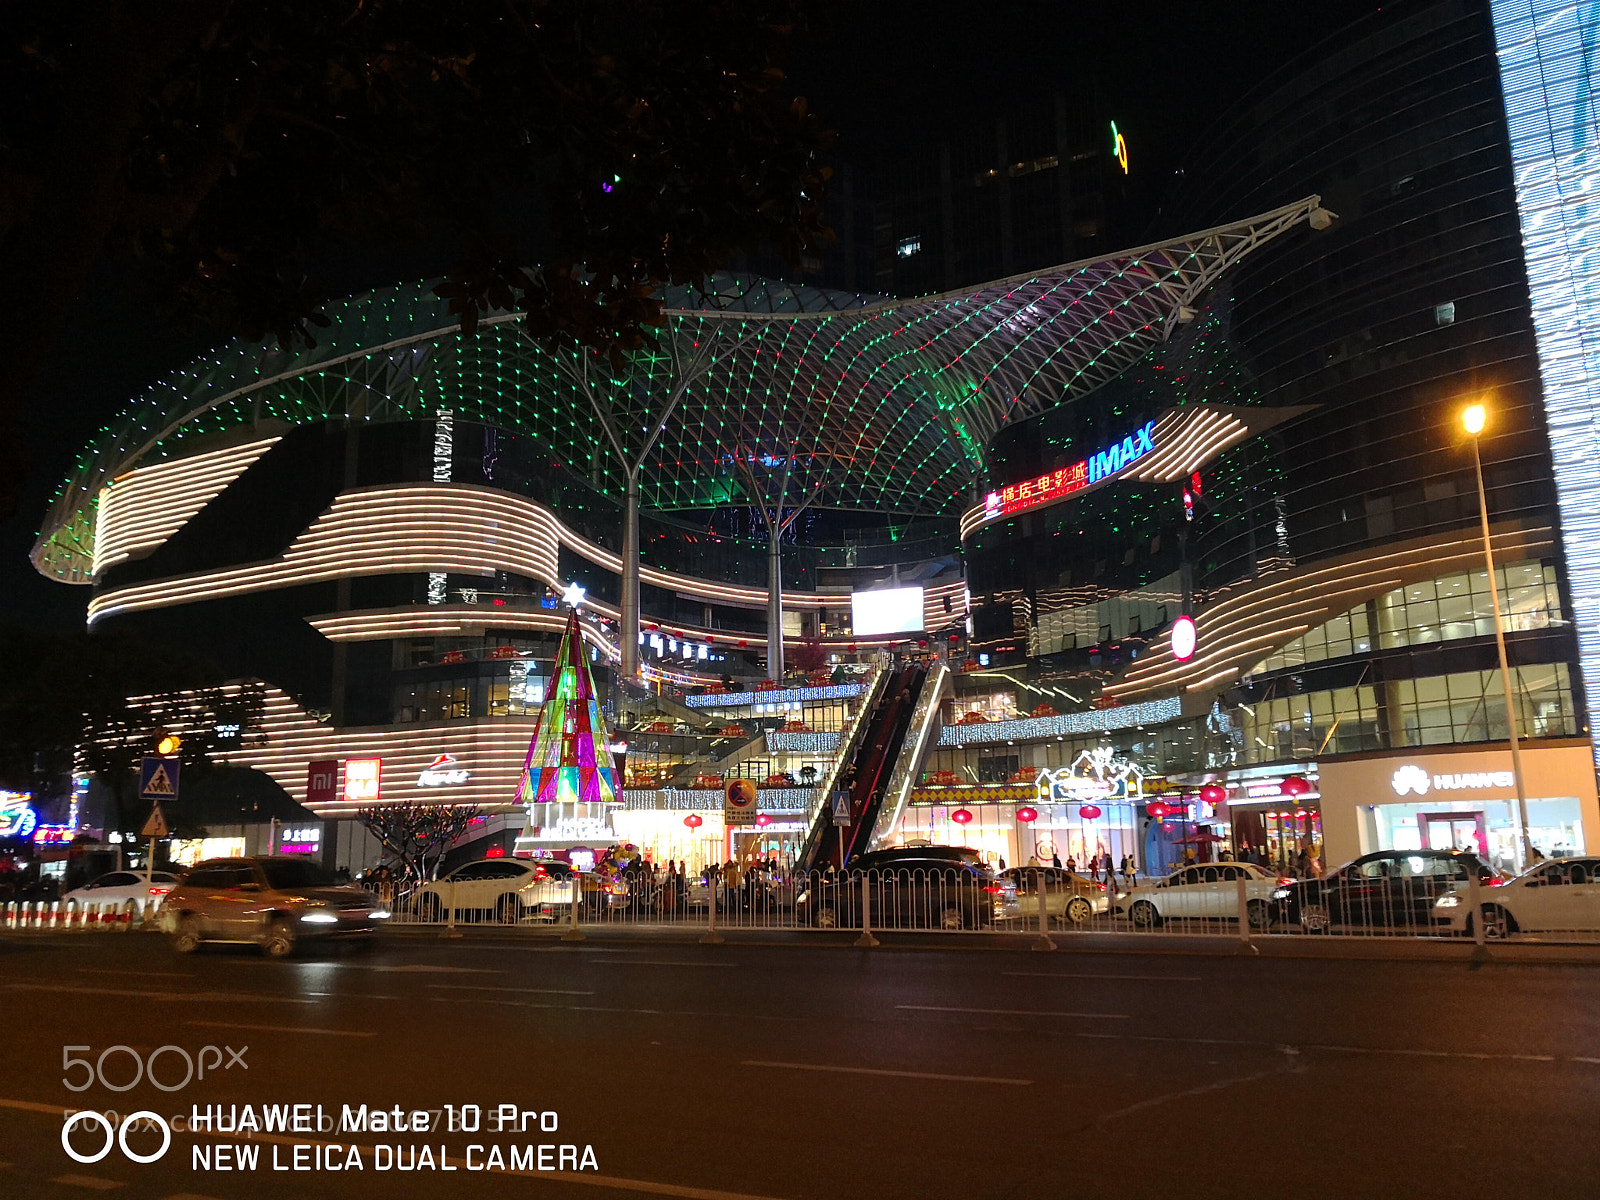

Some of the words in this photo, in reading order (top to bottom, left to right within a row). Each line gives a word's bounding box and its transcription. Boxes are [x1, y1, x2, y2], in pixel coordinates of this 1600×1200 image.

[1088, 421, 1155, 484] IMAX
[1002, 461, 1086, 505] 横店电影城
[1433, 771, 1514, 790] HUAWEI
